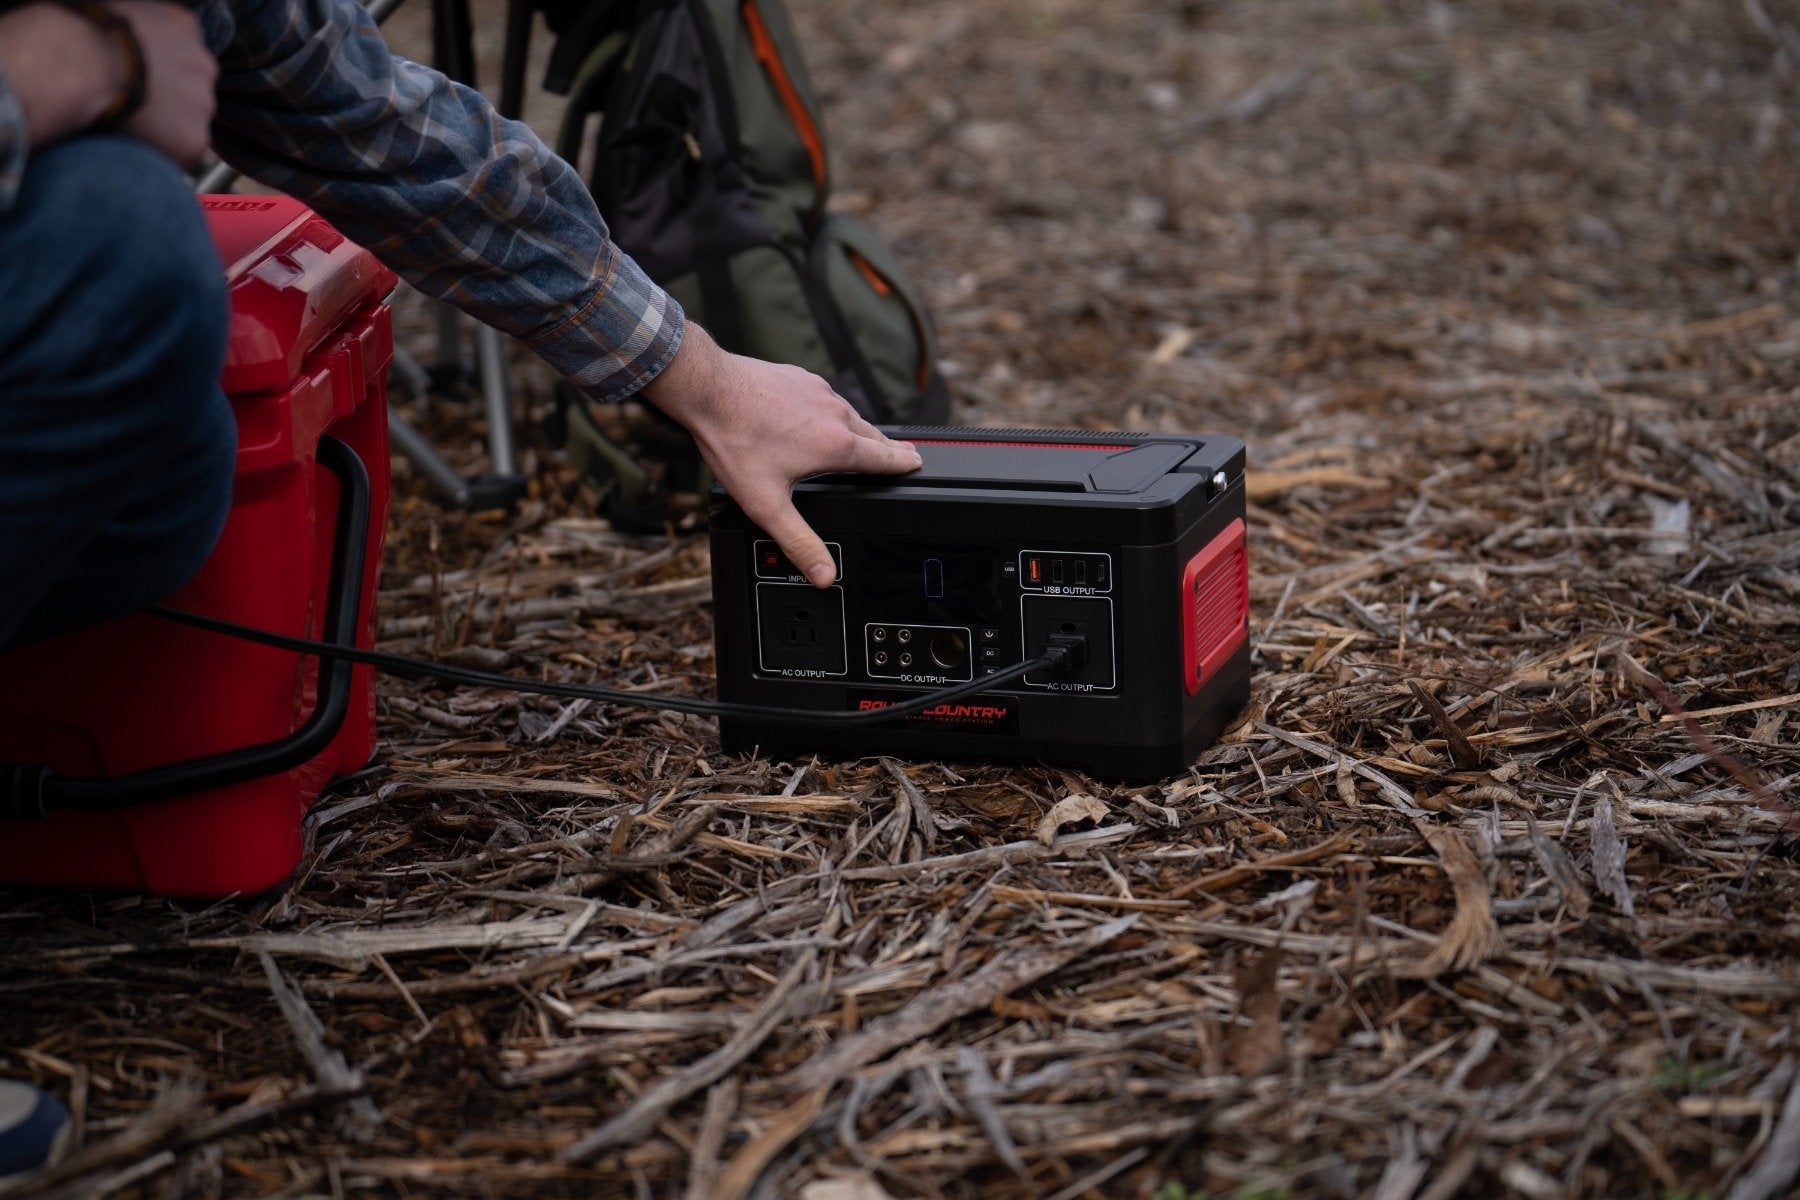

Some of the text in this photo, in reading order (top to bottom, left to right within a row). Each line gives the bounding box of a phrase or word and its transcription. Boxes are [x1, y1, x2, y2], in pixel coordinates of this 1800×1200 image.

[788, 574, 812, 583] INPU
[1043, 585, 1096, 595] USB OUTPUT
[782, 669, 826, 679] AC OUTPUT
[900, 674, 946, 685] DC OUTPUT
[1047, 682, 1093, 692] AC OUTPUT
